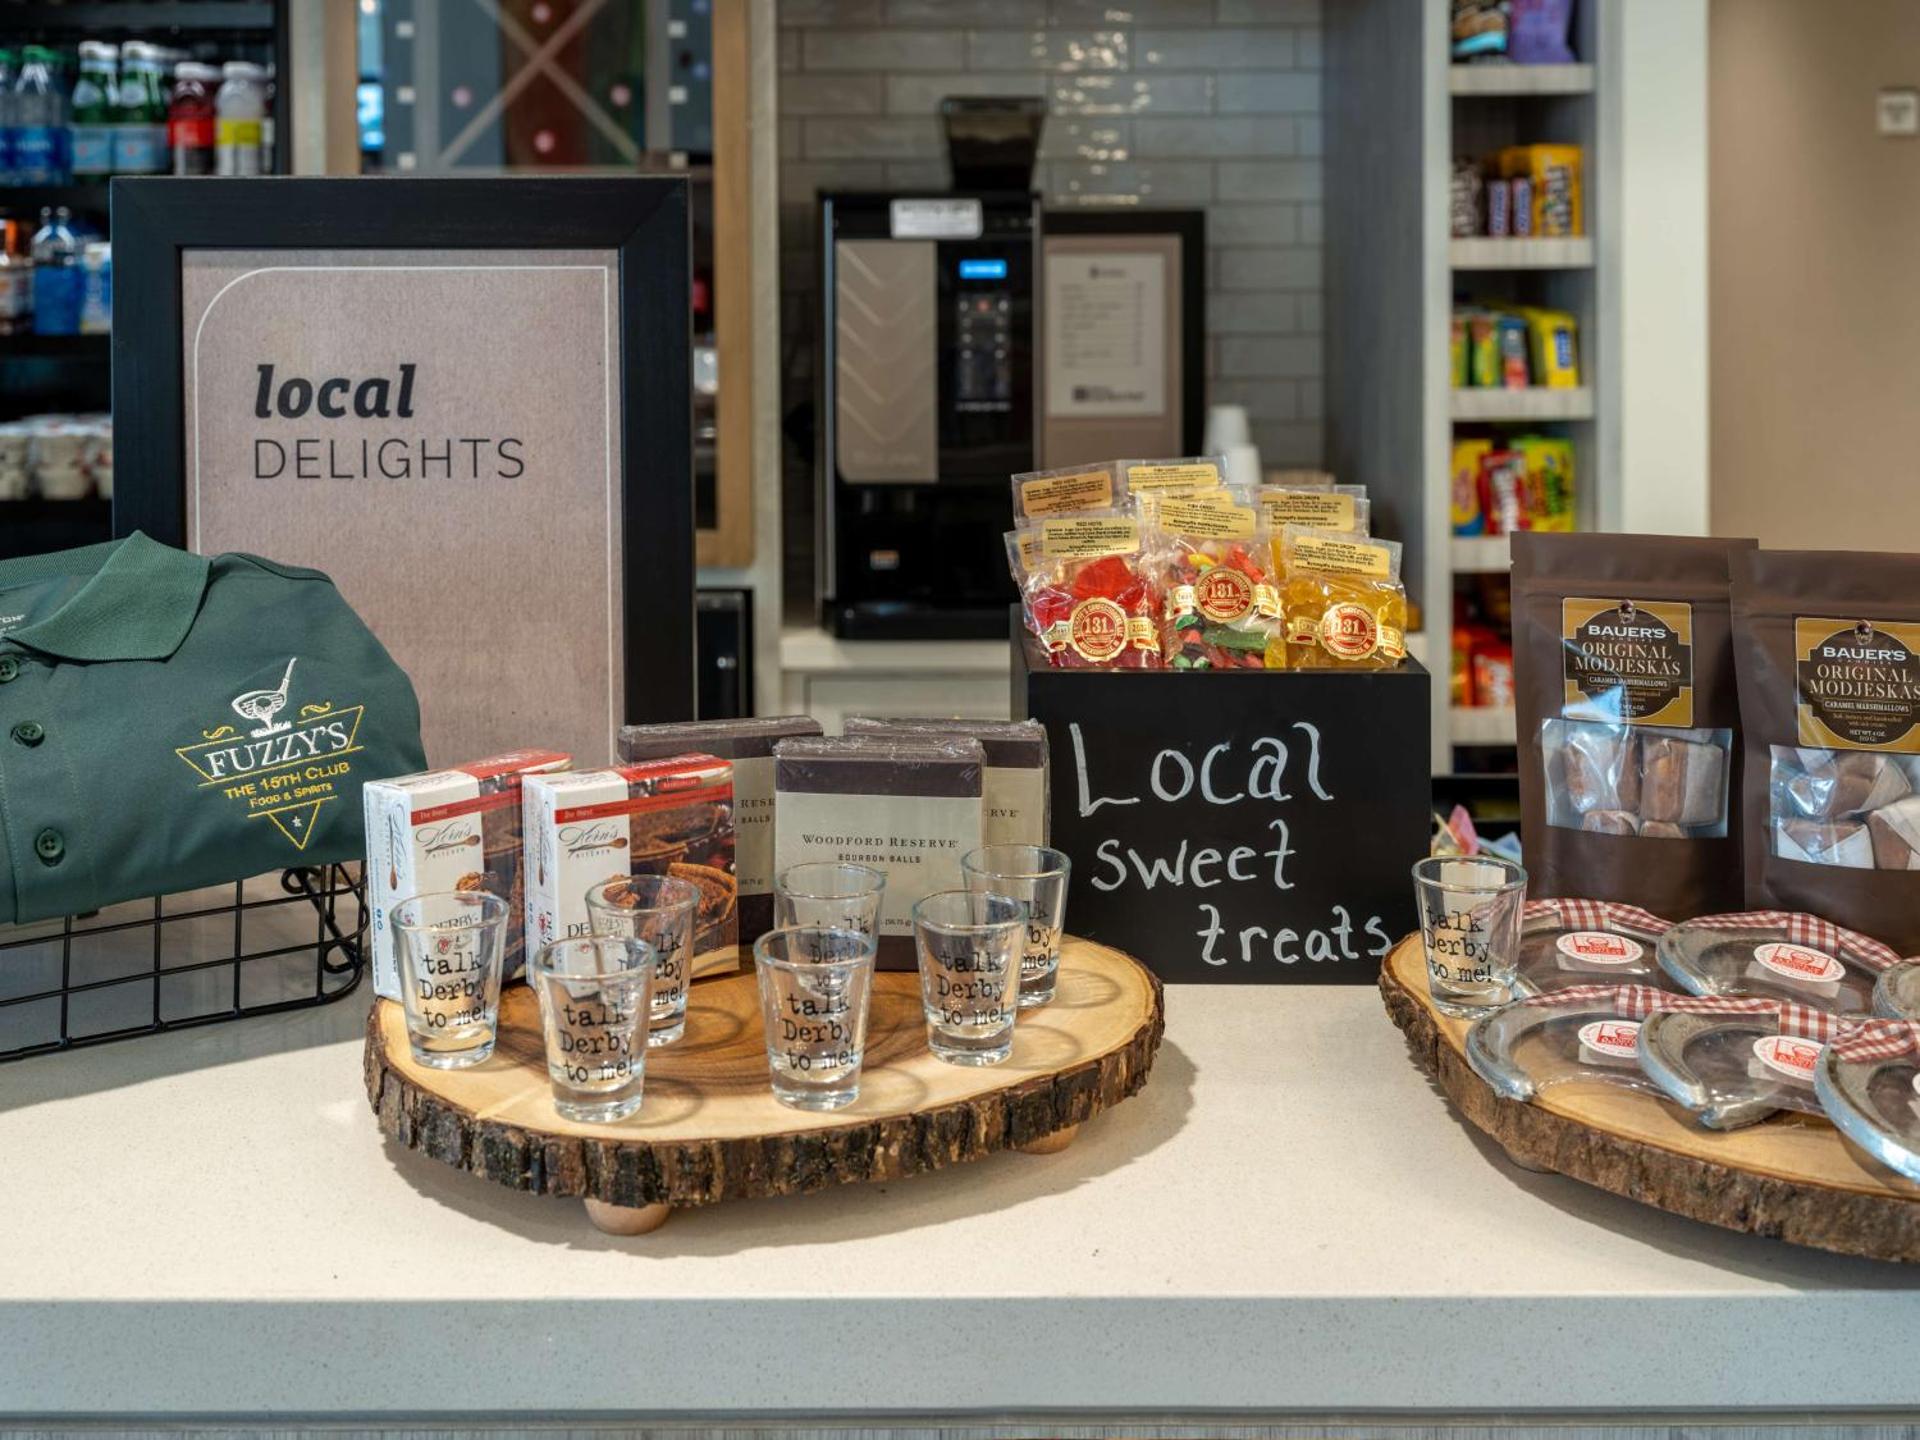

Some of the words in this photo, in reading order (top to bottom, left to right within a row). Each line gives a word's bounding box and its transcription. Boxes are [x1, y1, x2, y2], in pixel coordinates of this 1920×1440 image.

[254, 363, 417, 420] local
[254, 438, 526, 480] DELIGHTS
[1210, 582, 1234, 598] 131
[1085, 616, 1108, 634] 131
[1337, 620, 1360, 634] 131
[1588, 625, 1666, 639] BAUER'S
[1582, 642, 1672, 660] ORIGINAL
[1823, 647, 1907, 662] BAUER'S
[1575, 656, 1681, 676] MODJESKAS
[1816, 664, 1913, 682] ORIGINAL
[1810, 679, 1920, 700] MODJESKAS
[1824, 700, 1855, 709] CARAMEL
[1856, 702, 1910, 712] MARSHMALLOWS
[205, 722, 349, 778] FUZZY'S
[1069, 721, 1335, 818] Local
[224, 783, 257, 800] THE
[260, 772, 302, 791] 15TH
[802, 833, 883, 846] WOODFORD
[838, 854, 886, 862] BOURBON
[890, 856, 921, 864] BALLS
[1426, 906, 1484, 932] talk
[1196, 904, 1393, 965] treats
[1425, 928, 1490, 962] Derby
[422, 952, 482, 975] talk
[940, 950, 1002, 972] talk
[1430, 958, 1448, 979] to
[1456, 964, 1492, 982] me!
[420, 978, 486, 1000] Derby
[936, 973, 1005, 1002] Derby
[424, 1006, 447, 1028] to
[456, 1000, 487, 1026] me!
[564, 1003, 628, 1026] talk
[786, 992, 850, 1016] talk
[940, 1003, 962, 1026] to
[972, 1002, 1004, 1026] me!
[558, 1029, 634, 1054] Derby
[782, 1018, 853, 1044] Derby
[563, 1060, 588, 1083] to
[598, 1054, 634, 1080] me!
[786, 1046, 811, 1071] to
[821, 1044, 856, 1070] me!
